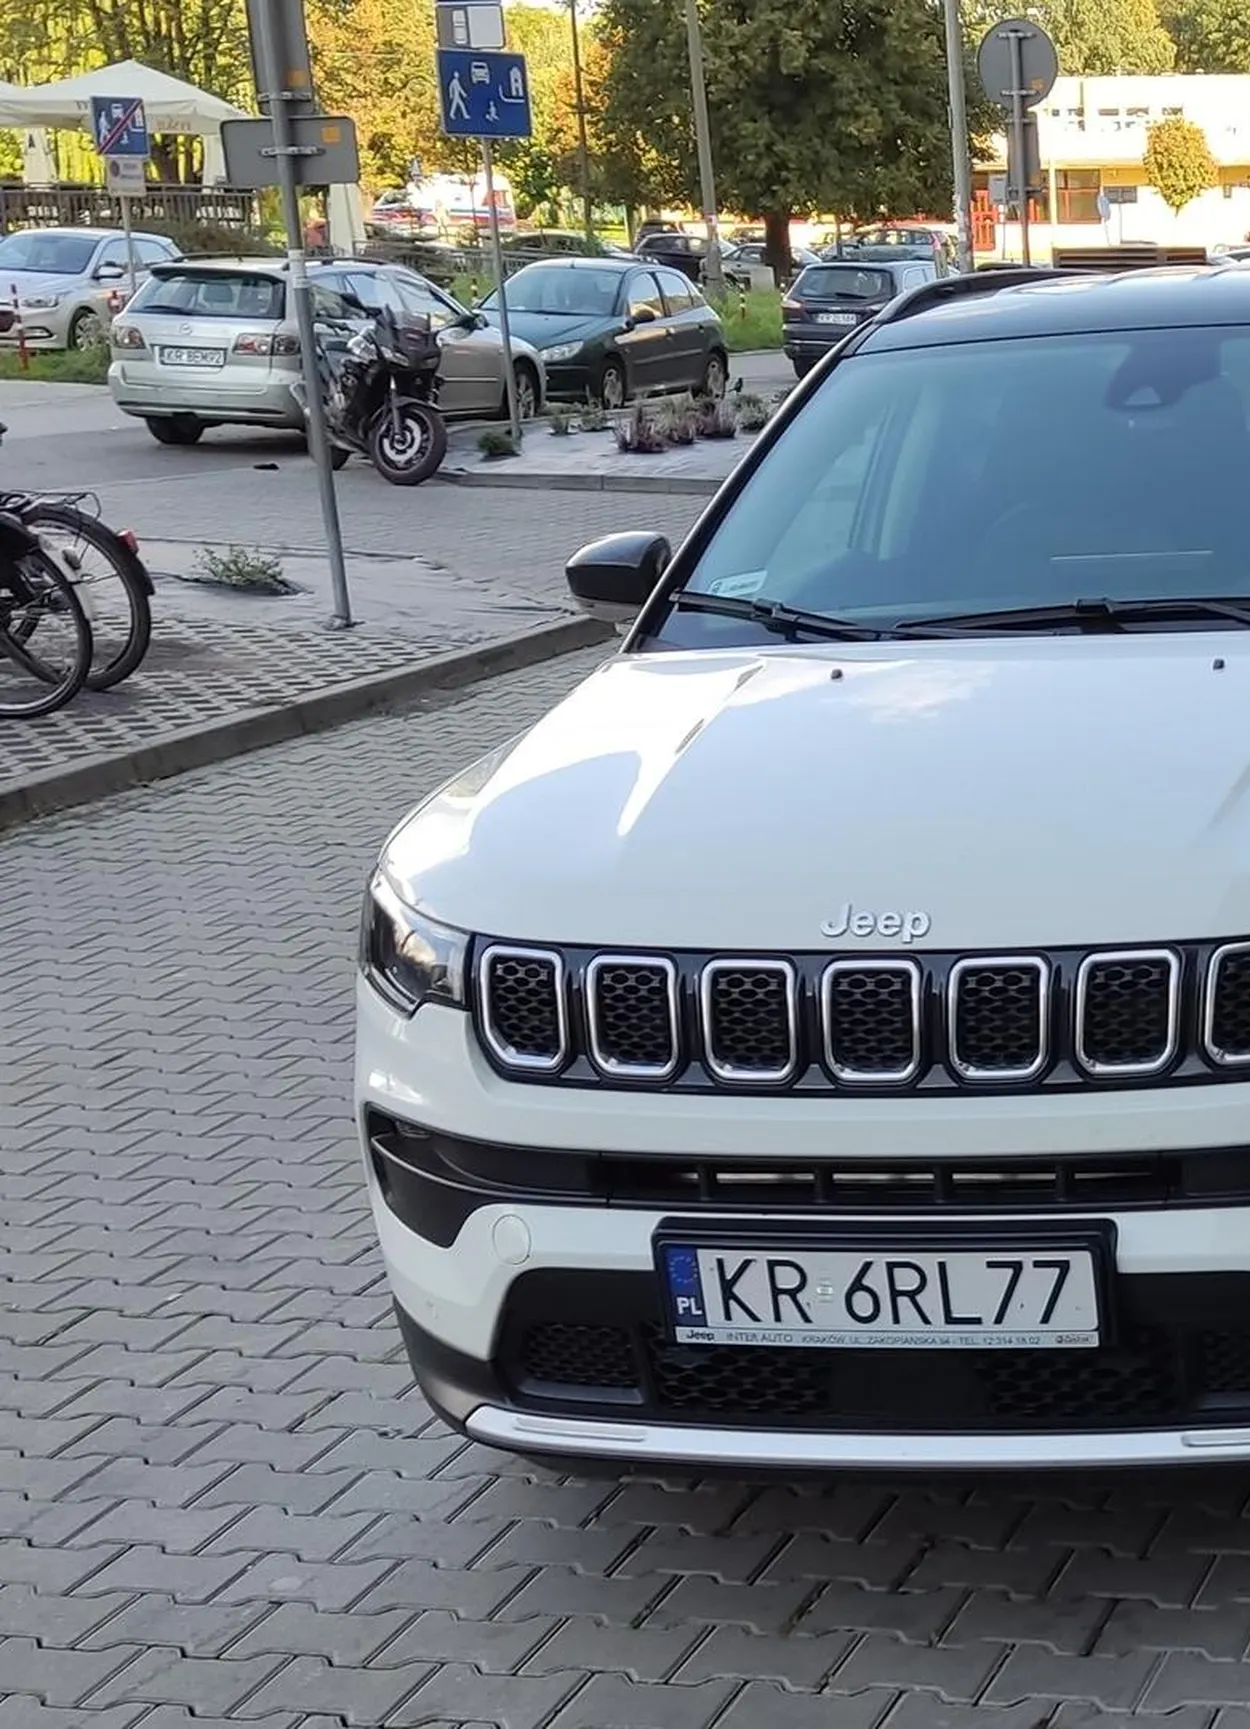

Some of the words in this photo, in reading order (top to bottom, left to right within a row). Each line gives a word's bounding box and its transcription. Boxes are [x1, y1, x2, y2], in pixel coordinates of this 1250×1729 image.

[819, 902, 932, 944] Jeep
[715, 1257, 813, 1324] KR
[844, 1260, 1071, 1326] 6RL77
[676, 1297, 703, 1315] PL
[685, 1330, 715, 1342] Jeep
[725, 1332, 758, 1343] INTER
[760, 1333, 793, 1343] AUTO
